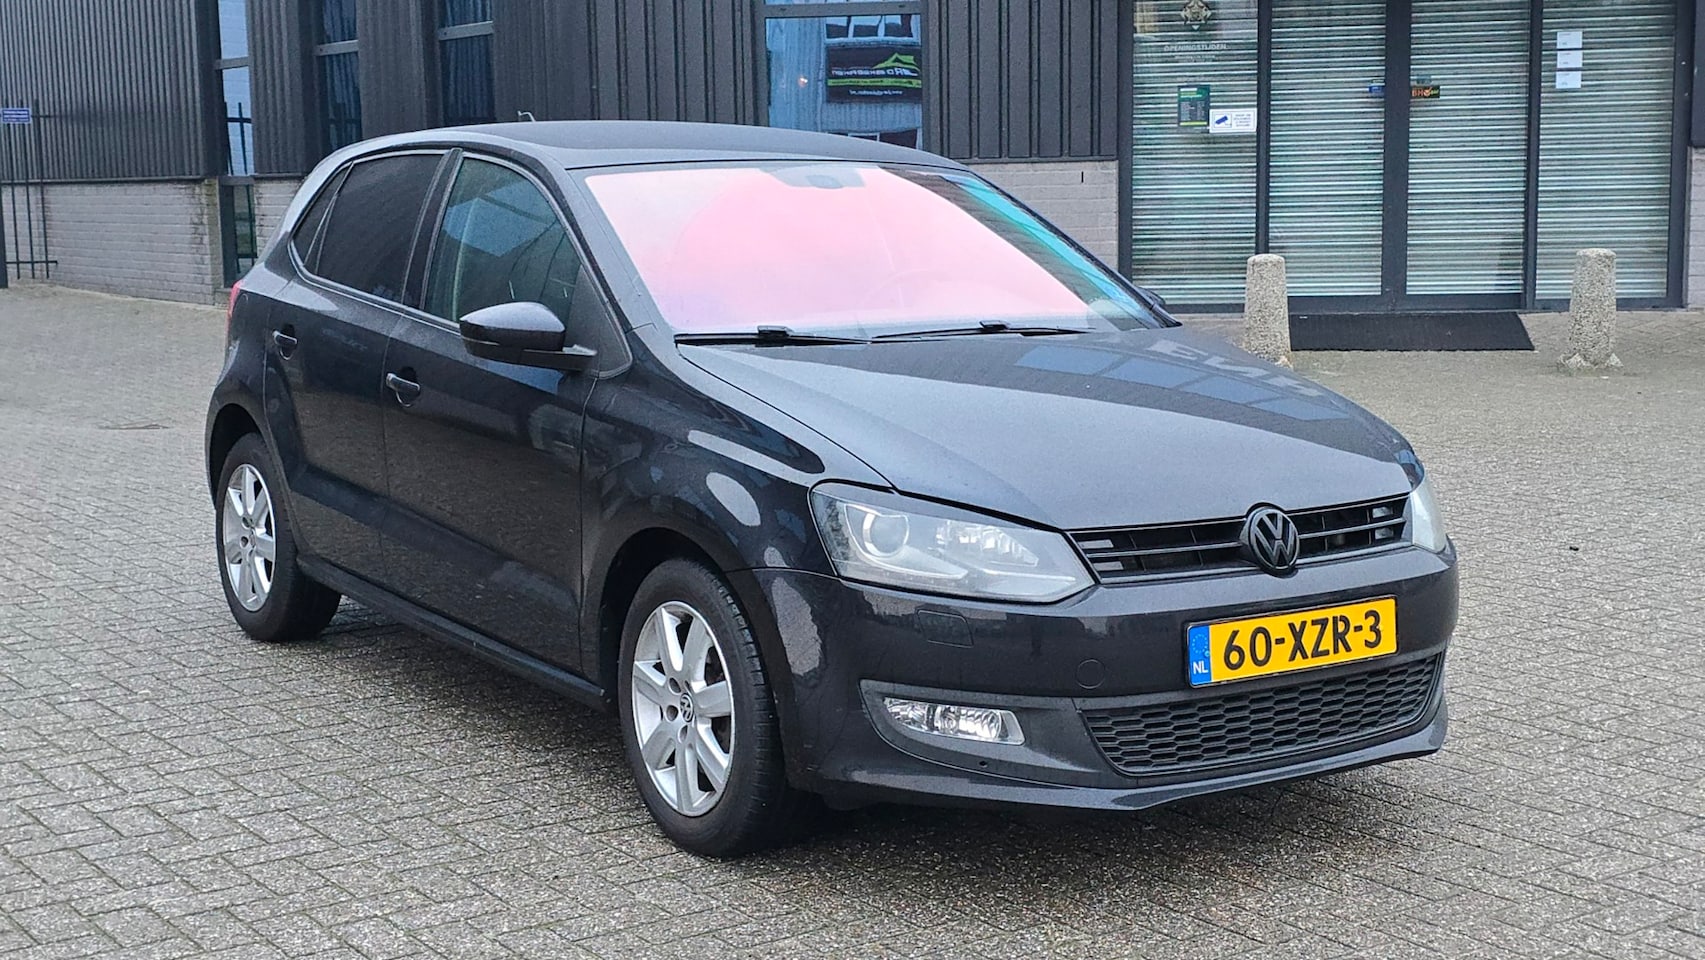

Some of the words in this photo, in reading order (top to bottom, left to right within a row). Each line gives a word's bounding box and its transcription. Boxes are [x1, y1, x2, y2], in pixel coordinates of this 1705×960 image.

[1249, 507, 1300, 570] VW
[1192, 660, 1209, 675] NL
[1223, 609, 1382, 671] 60-XZR-3
